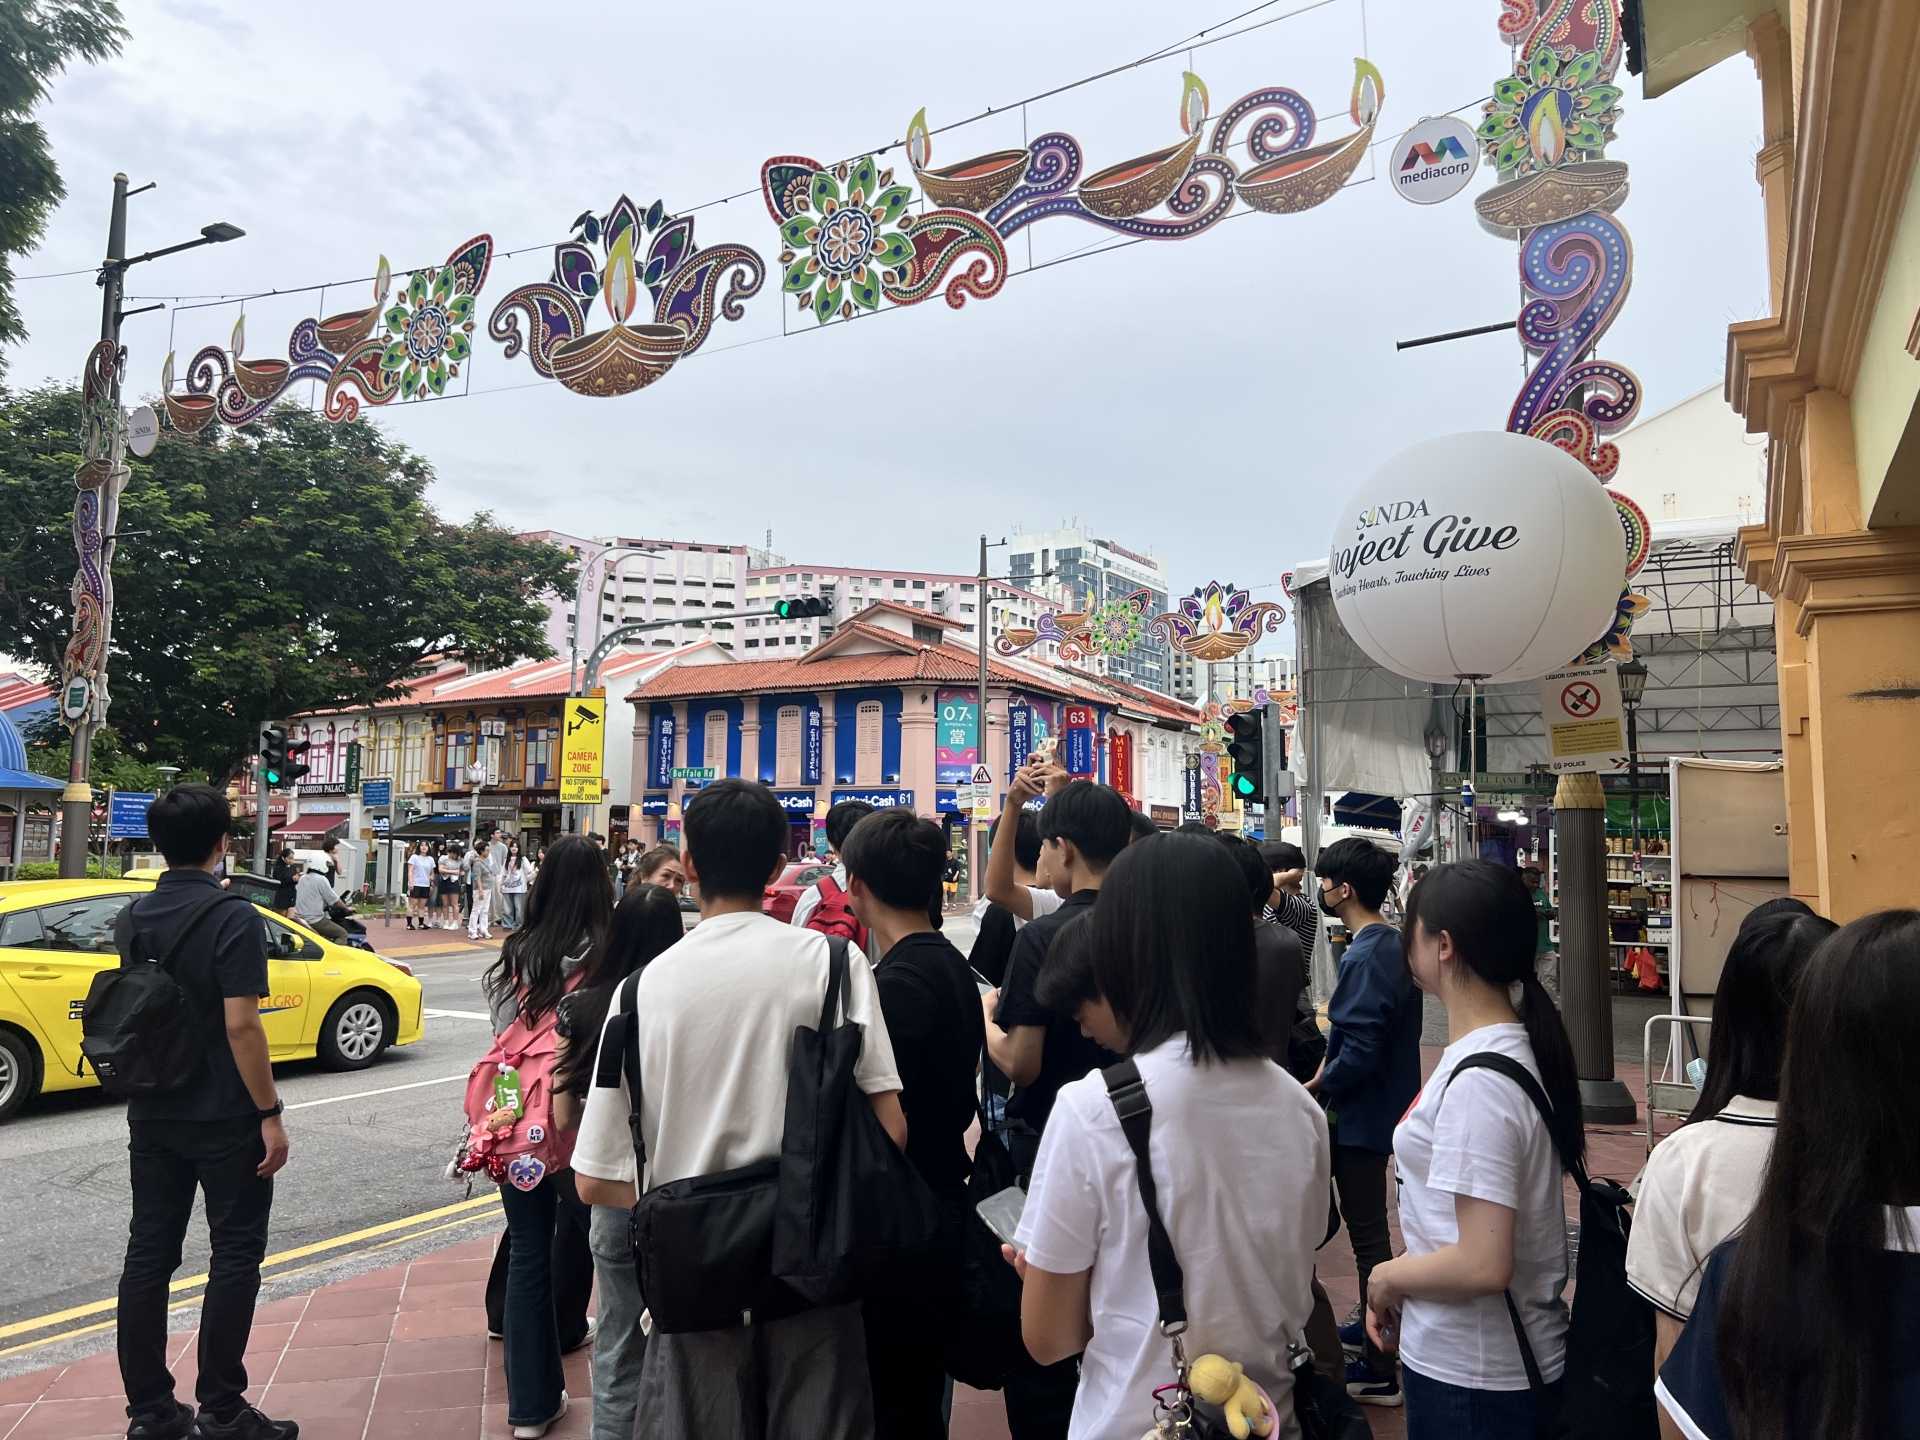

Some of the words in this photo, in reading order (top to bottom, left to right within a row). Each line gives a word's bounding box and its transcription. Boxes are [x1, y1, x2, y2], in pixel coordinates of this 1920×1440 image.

[1400, 162, 1469, 185] mediacorp
[1423, 514, 1521, 560] Give
[1394, 566, 1450, 584] Touching
[1453, 564, 1491, 578] Lives
[1566, 670, 1591, 679] CONTROL
[1070, 711, 1086, 724] 63
[567, 751, 598, 761] CAMERA
[572, 763, 592, 773] ZONE
[672, 769, 701, 778] Buffalo
[703, 768, 713, 778] Rd
[573, 778, 598, 786] STOPPING
[299, 784, 323, 794] FASHION
[324, 783, 346, 793] PALACE
[561, 793, 584, 801] SLOWING
[584, 793, 600, 801] DOWN
[779, 796, 813, 808] xi-Cash
[899, 793, 912, 804] 61
[259, 994, 304, 1009] ELGRO
